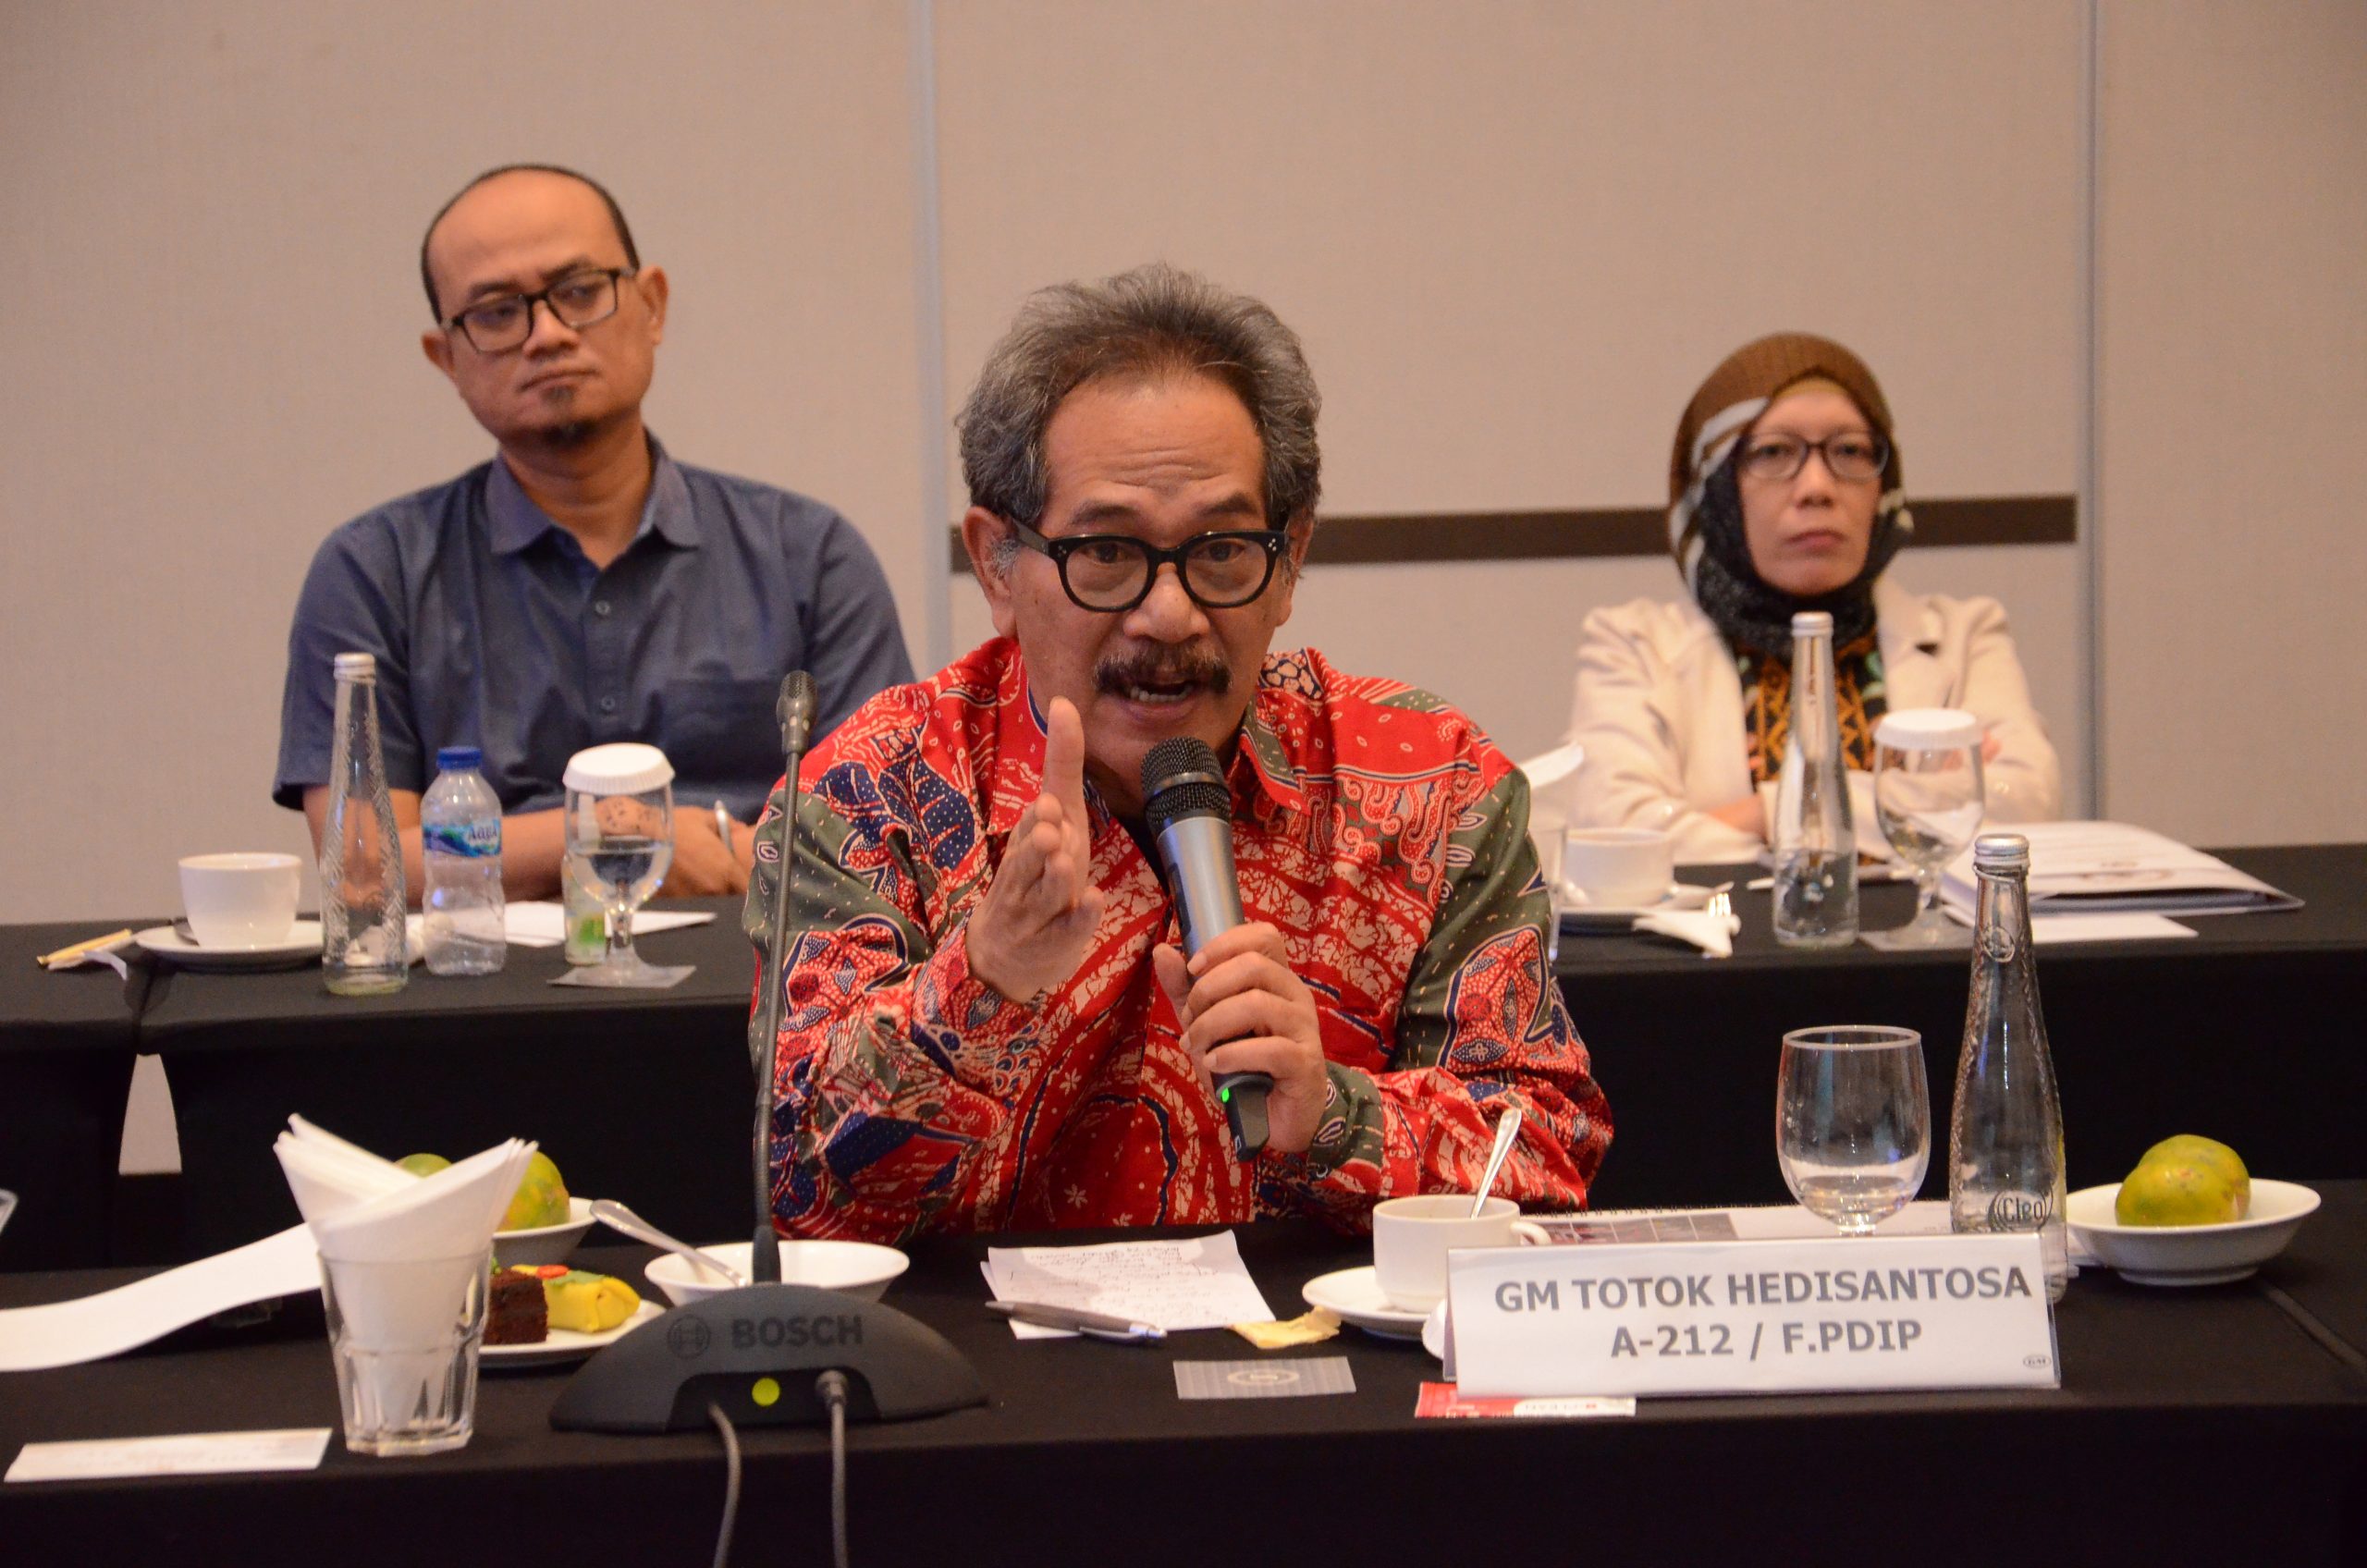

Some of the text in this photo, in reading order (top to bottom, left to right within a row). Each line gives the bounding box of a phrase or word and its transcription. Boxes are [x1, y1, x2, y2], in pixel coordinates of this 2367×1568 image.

[2003, 1196, 2043, 1223] Cleo
[1494, 1266, 2032, 1313] GM TOTOK HEDISANTOSA
[730, 1314, 865, 1350] BOSCH
[1611, 1319, 1922, 1362] A-212 / F.PDIP
